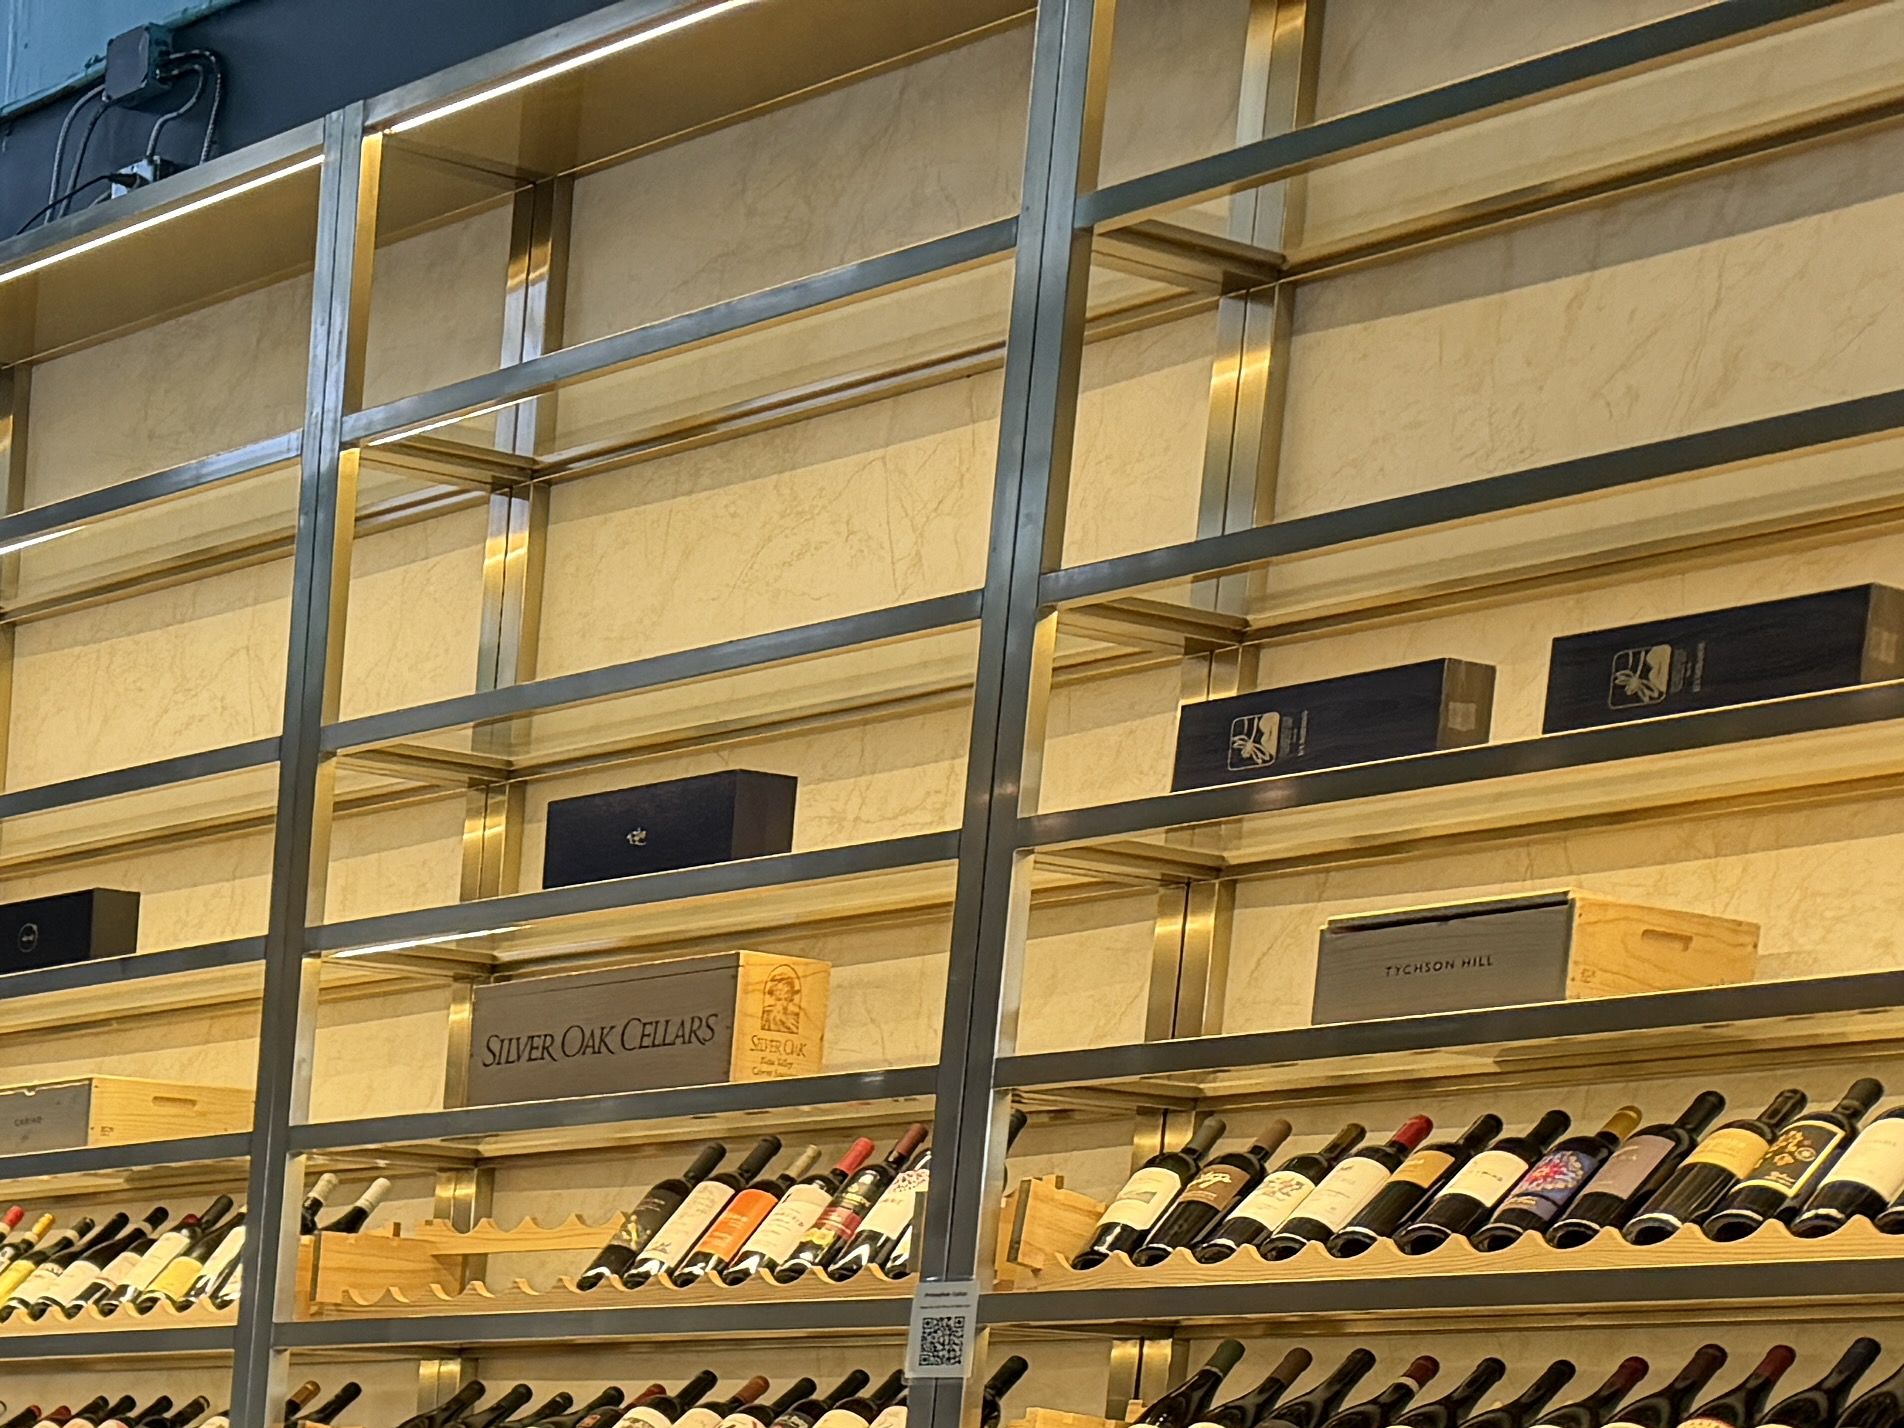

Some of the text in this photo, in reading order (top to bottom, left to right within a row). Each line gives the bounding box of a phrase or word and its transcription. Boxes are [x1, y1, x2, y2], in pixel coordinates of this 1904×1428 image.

[1385, 955, 1494, 977] TYCHSON HILL
[482, 1013, 720, 1068] SILVER OAK CELLARS
